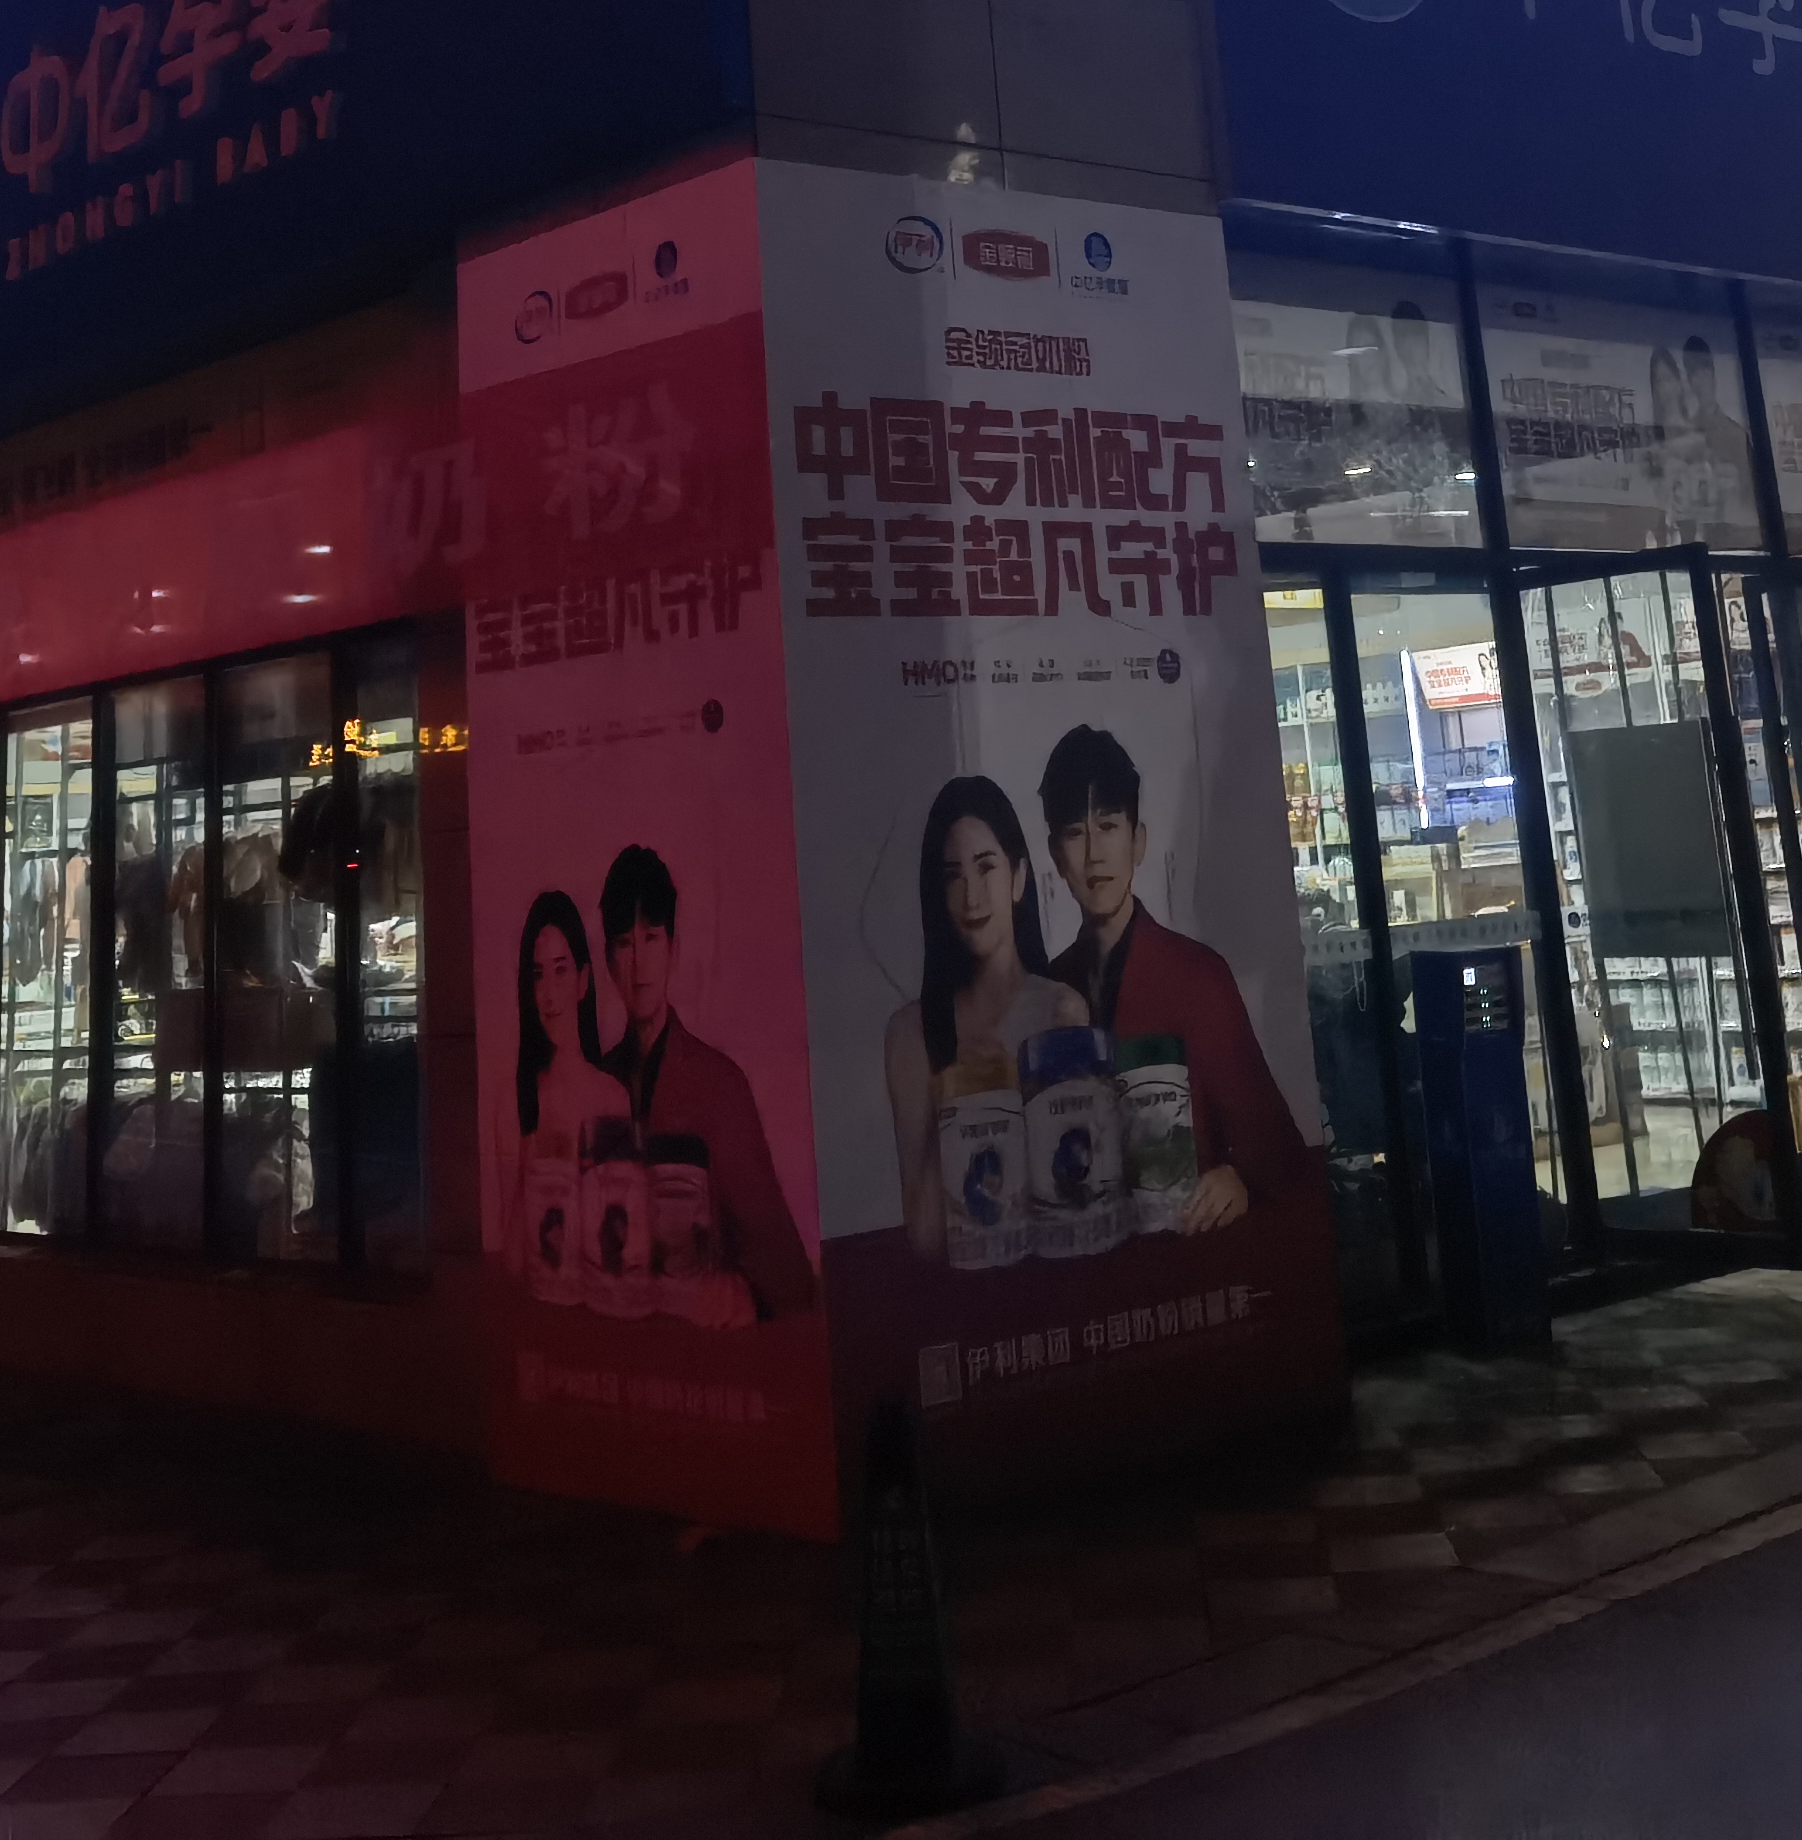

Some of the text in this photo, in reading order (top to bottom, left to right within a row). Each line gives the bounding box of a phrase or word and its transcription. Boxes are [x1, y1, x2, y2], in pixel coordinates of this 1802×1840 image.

[793, 390, 1225, 514] 中国专利配方
[802, 512, 1238, 618] 宝宝超凡守护
